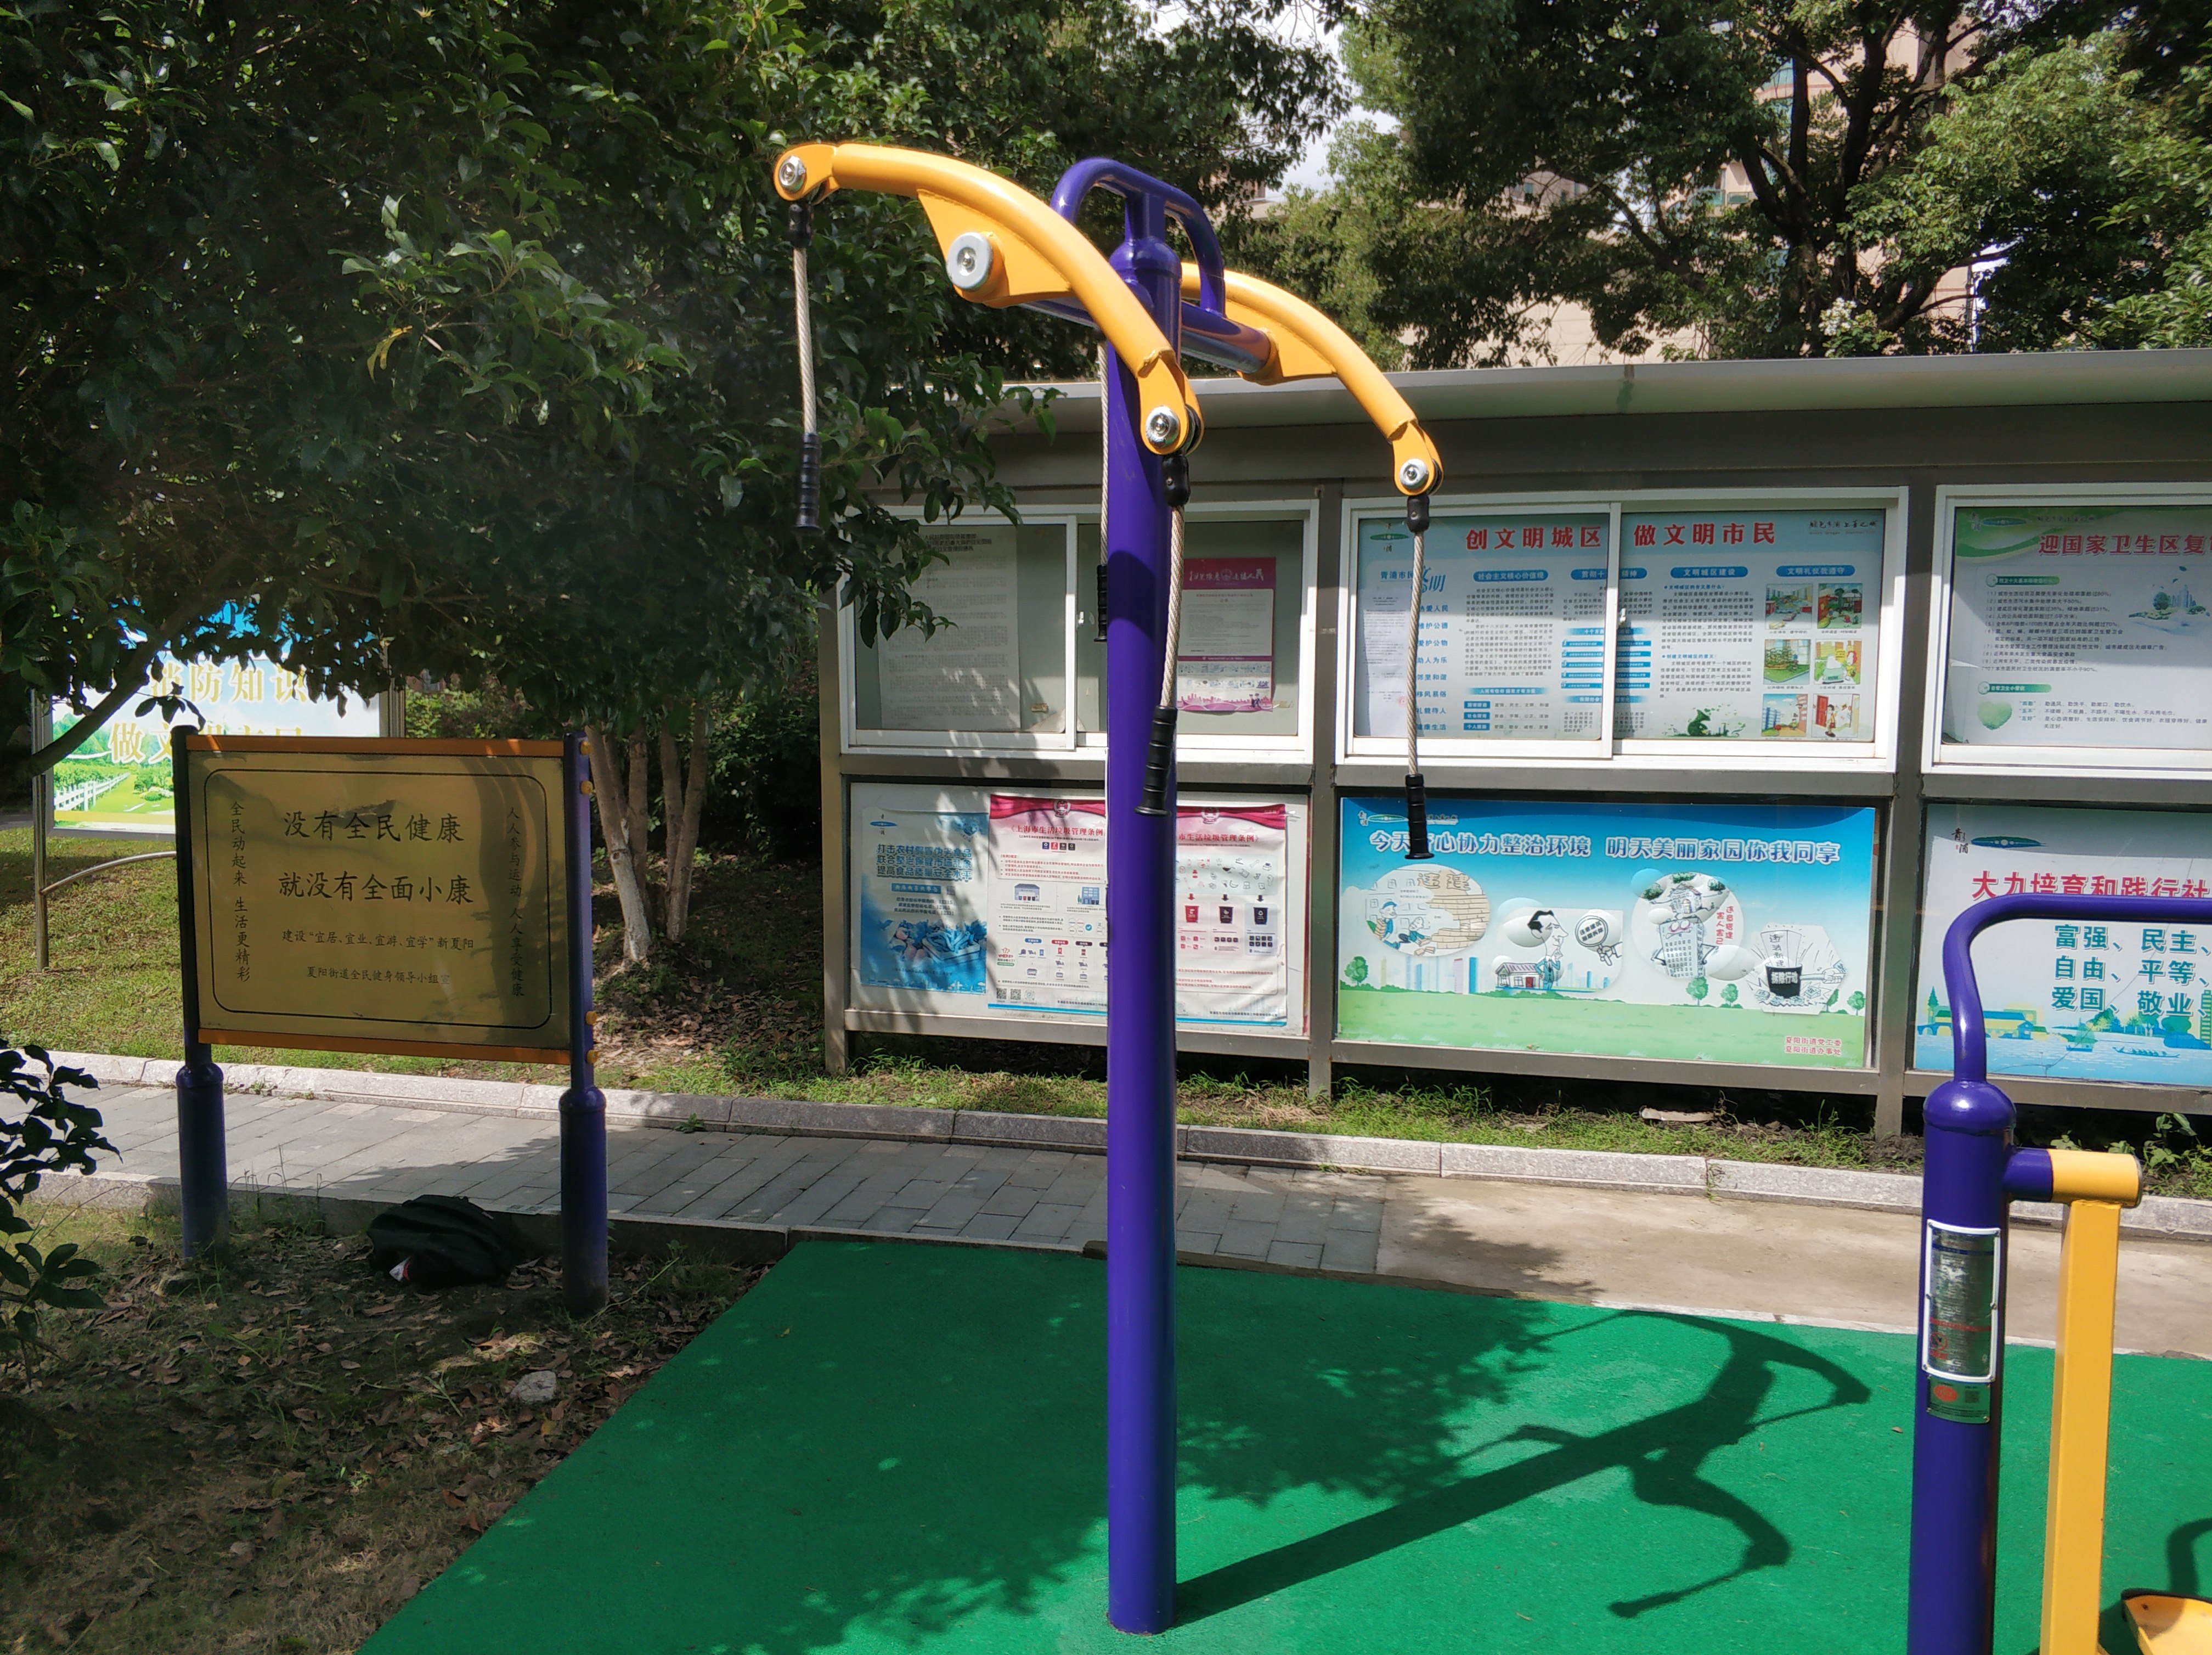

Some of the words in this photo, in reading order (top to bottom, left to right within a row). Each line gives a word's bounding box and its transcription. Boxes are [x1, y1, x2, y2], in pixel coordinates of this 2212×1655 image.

[1466, 525, 1601, 550] 创文明城区
[1633, 521, 1776, 547] 做文明市民
[2039, 534, 2212, 555] 迎国家卫生区复
[1478, 572, 1544, 581] 社会主义核心价值观
[1684, 568, 1736, 577] 文明城区建设
[1787, 567, 1845, 575] 文明礼仪我遵守
[150, 663, 308, 703] 消防知识
[284, 809, 466, 844] 没有全民健康
[230, 801, 250, 886] 全民动起来
[506, 806, 523, 898] 人人参与运动
[1370, 830, 1592, 858] 今天心协力整治环境
[1606, 837, 1841, 864] 明天美丽家园你我同享
[877, 866, 972, 879] 提高食品质量安全水平
[278, 871, 475, 905] 就没有全面小康
[234, 897, 251, 983] 生活更精彩
[1716, 911, 1724, 945] 害人害己
[2054, 924, 2211, 955] 富强、民主、
[508, 907, 526, 997] 人人享受健康
[306, 966, 451, 986] 夏阳街道全民健身领导小组宣
[1771, 972, 1798, 984] 拆除行动
[2055, 955, 2210, 986] 自由、平等、
[2052, 987, 2208, 1016] 爱国、敬业、
[1785, 1045, 1841, 1055] 夏阳街道办事处
[1786, 1036, 1841, 1046] 夏阳街道党工委
